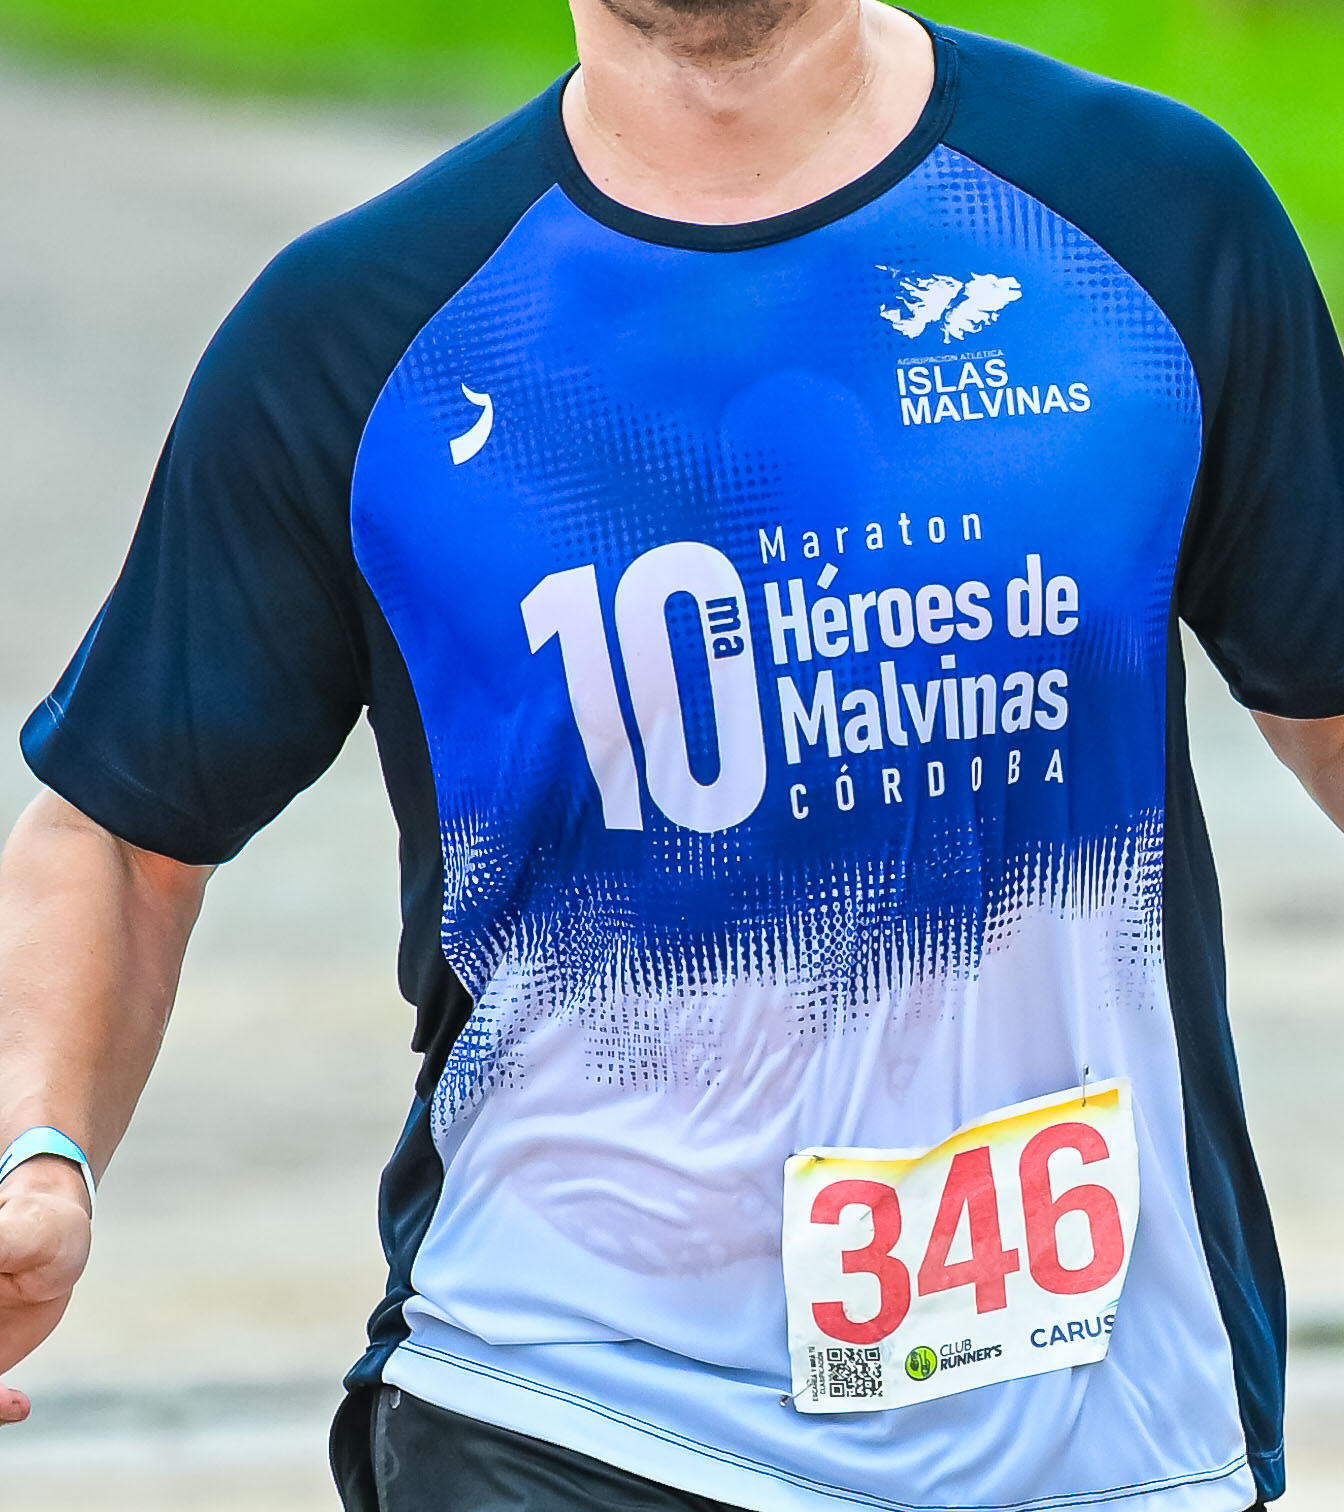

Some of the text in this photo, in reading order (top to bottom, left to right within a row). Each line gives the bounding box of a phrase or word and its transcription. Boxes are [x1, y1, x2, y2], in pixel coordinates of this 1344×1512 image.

[896, 358, 1009, 397] ISLAS
[900, 381, 1092, 426] MALVINAS
[758, 511, 982, 565] Maraton
[704, 595, 745, 660] ma
[763, 553, 1080, 666] Héroes de
[519, 540, 768, 834] 10
[776, 653, 1069, 765] Malvinas
[789, 747, 1065, 821] CÓRDOBA
[809, 1120, 1126, 1346] 346
[939, 1338, 973, 1358] CLUB
[939, 1343, 1004, 1372] RUNNER'S
